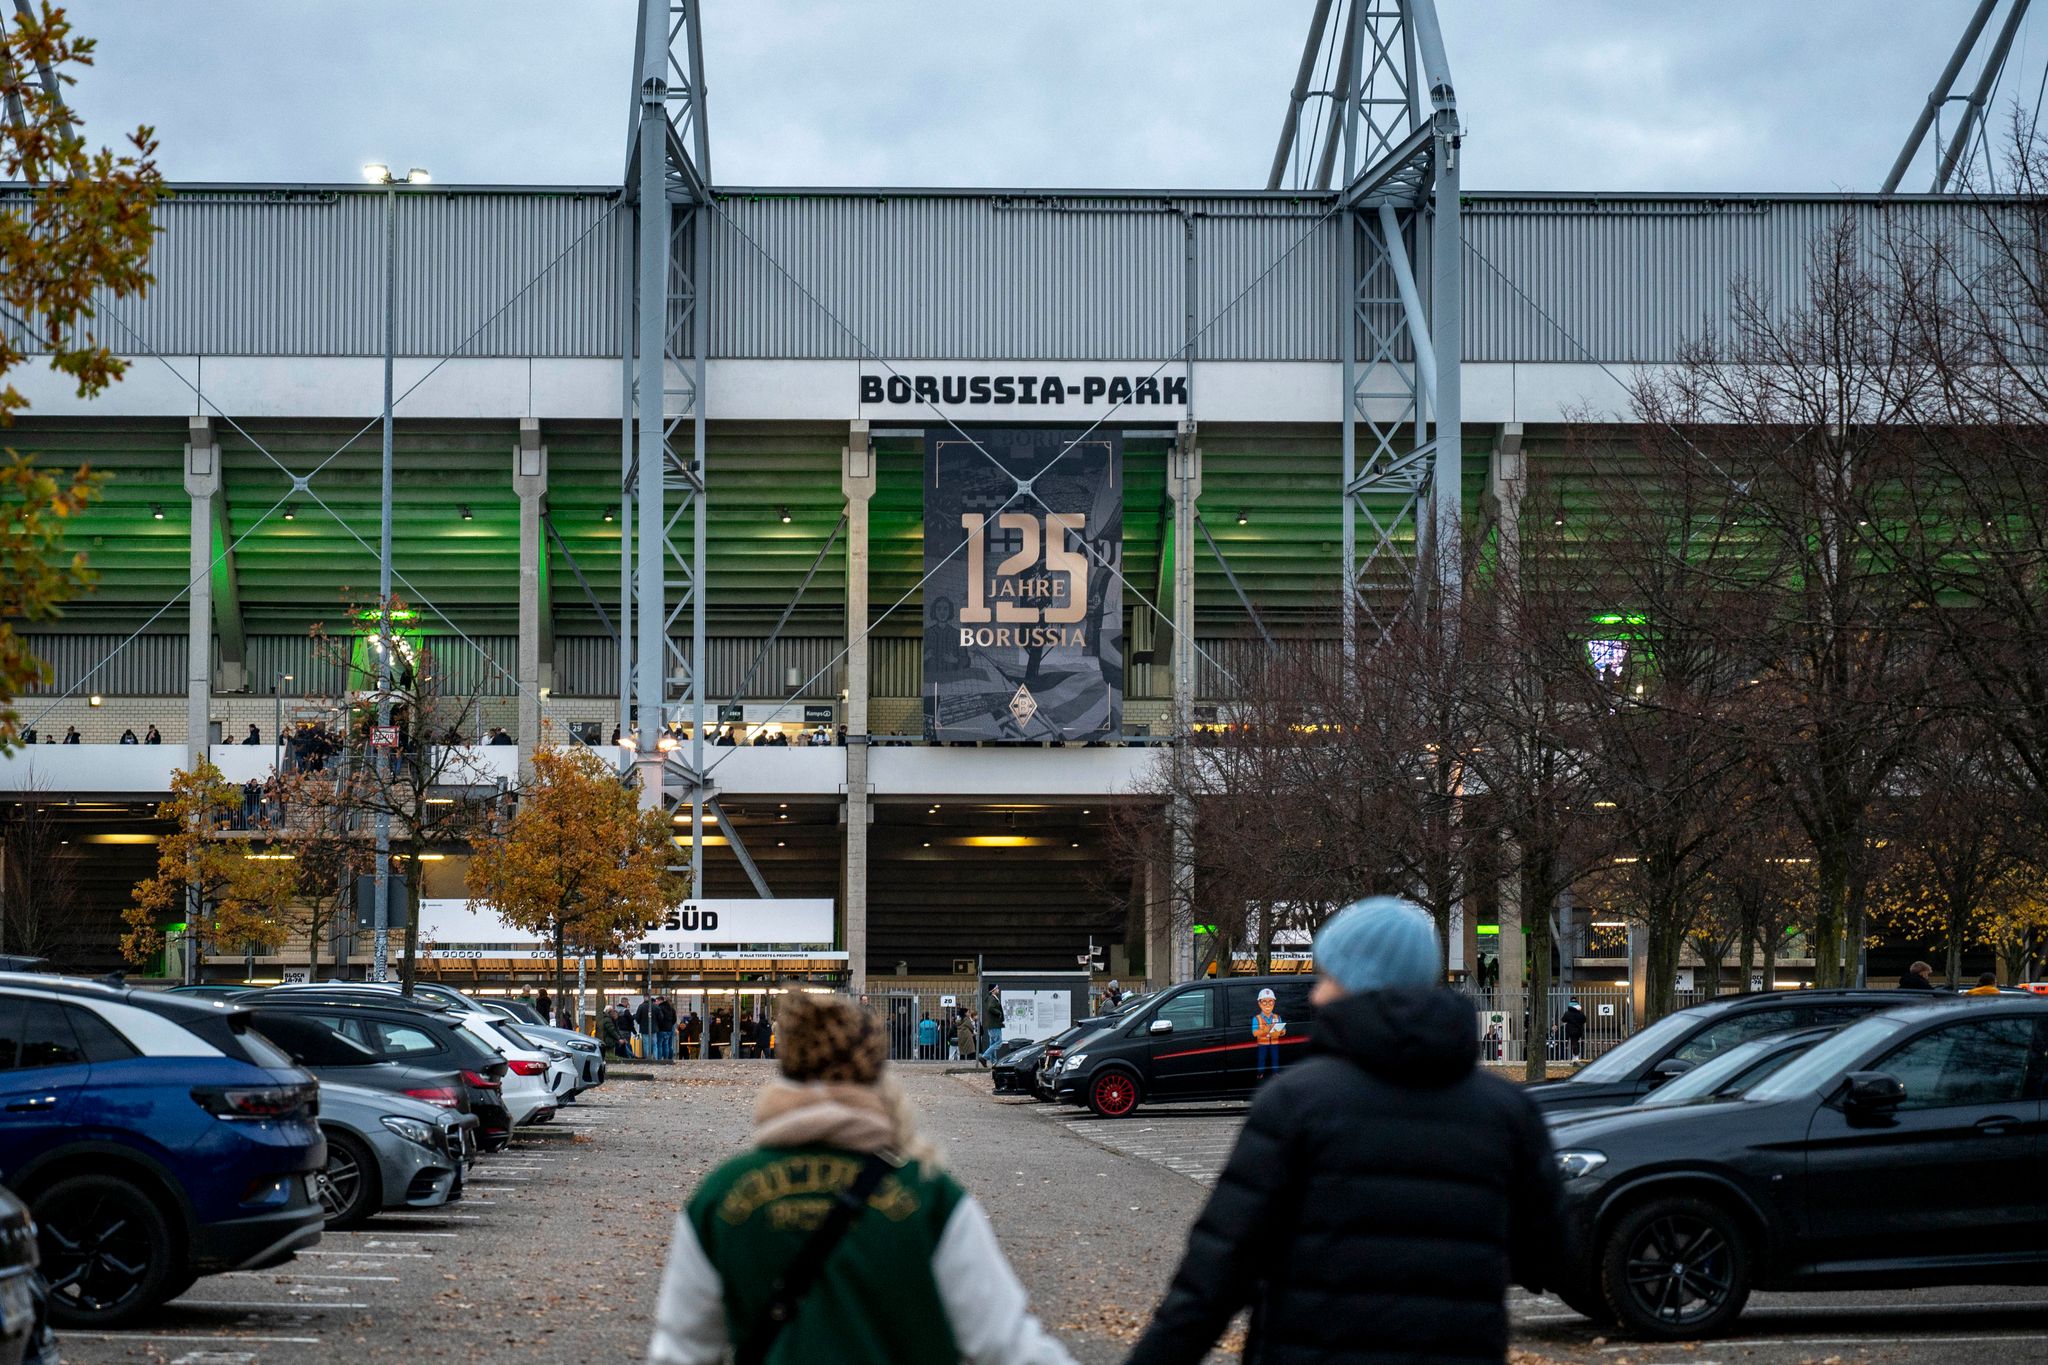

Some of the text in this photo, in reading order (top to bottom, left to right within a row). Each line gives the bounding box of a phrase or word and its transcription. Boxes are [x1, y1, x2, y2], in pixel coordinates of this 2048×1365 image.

[860, 375, 1188, 405] BORUSSIA-PARK
[960, 513, 1088, 623] 125
[988, 579, 1065, 598] JAHRE
[960, 628, 1086, 647] BORUSSIA
[665, 906, 719, 931] SÜD
